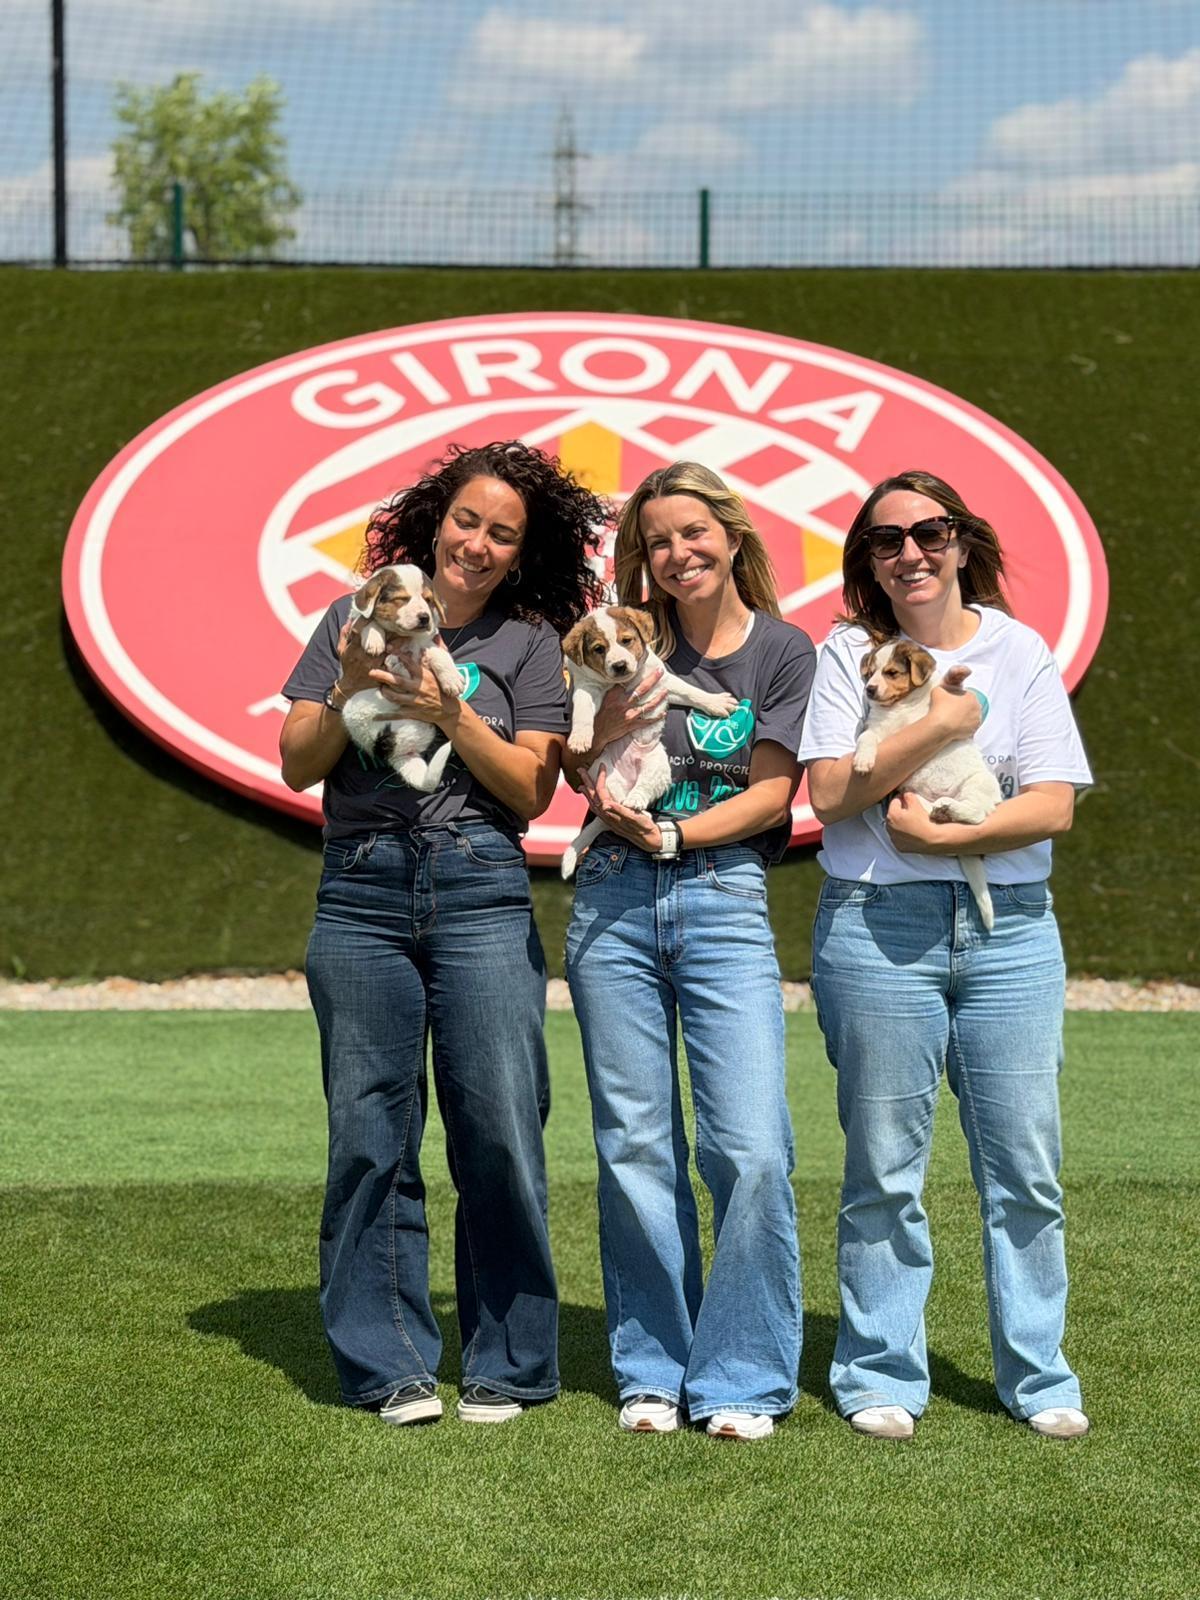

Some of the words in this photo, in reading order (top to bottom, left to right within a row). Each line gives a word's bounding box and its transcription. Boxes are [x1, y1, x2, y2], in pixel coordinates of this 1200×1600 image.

[291, 338, 884, 453] GIRONA
[479, 715, 505, 727] ORA
[656, 779, 699, 811] ova
